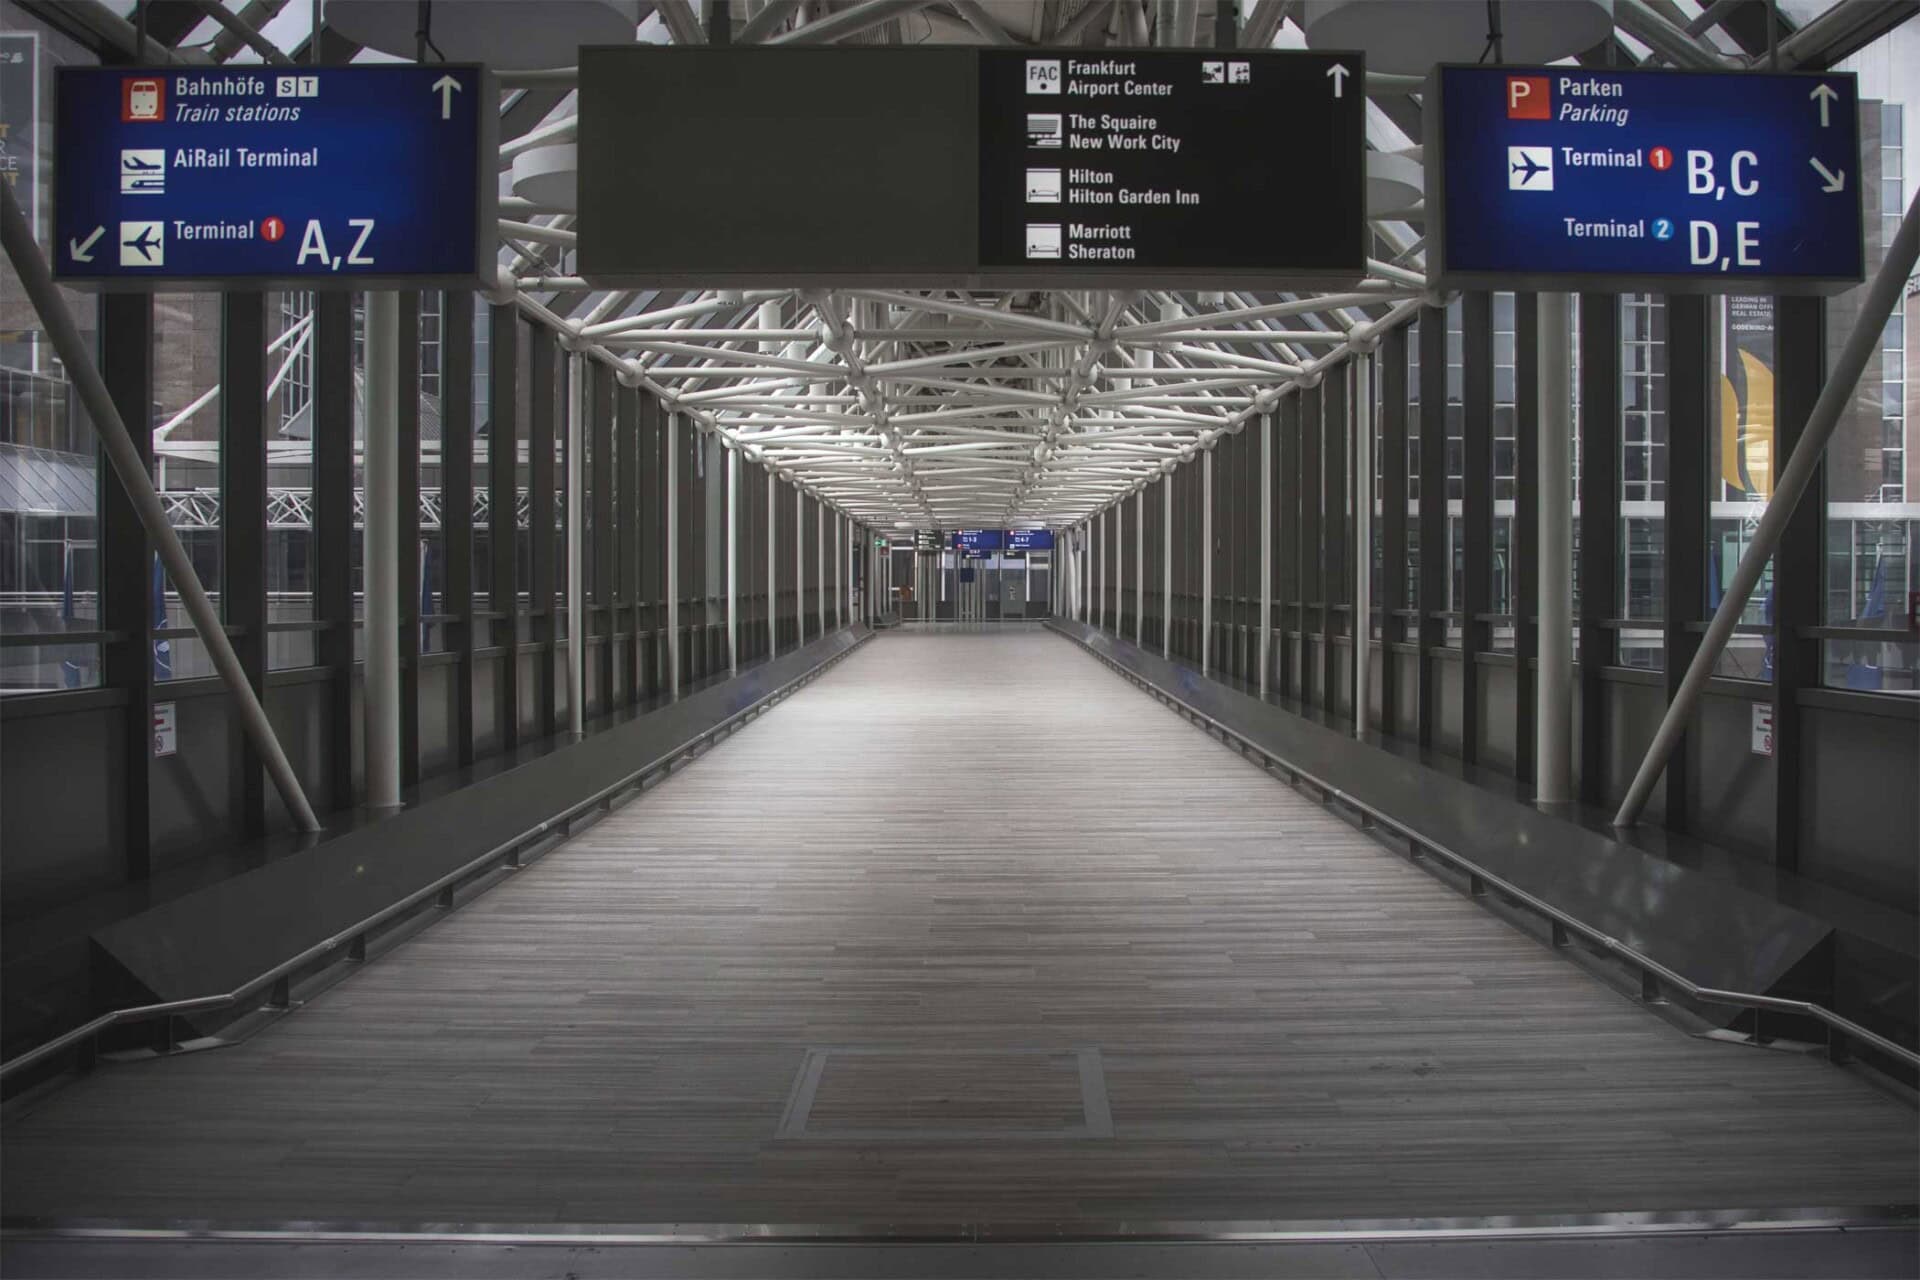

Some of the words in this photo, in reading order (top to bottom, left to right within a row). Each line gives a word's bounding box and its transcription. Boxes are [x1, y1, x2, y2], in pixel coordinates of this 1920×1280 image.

[1030, 66, 1057, 81] FAC
[1068, 59, 1136, 75] Frankfurt
[175, 77, 265, 95] Bahnhöfe
[280, 79, 293, 95] S
[302, 79, 315, 95] T
[1068, 80, 1120, 99] Airport
[1124, 80, 1173, 96] Center
[1510, 81, 1531, 108] P
[1560, 77, 1623, 97] Parken
[174, 103, 219, 122] Train
[225, 103, 300, 122] stations
[1558, 103, 1629, 128] Parking
[1069, 114, 1096, 129] The
[1100, 114, 1157, 133] Squaire
[1069, 134, 1103, 150] New
[1107, 134, 1147, 150] Work
[1151, 134, 1181, 153] City
[174, 148, 231, 168] AiRail
[236, 148, 318, 168] Terminal
[1069, 168, 1114, 185] Hilton
[1561, 146, 1643, 168] Terminal
[1654, 149, 1665, 168] 1
[1686, 149, 1760, 201] B,C
[1069, 188, 1114, 205] Hilton
[1118, 188, 1171, 205] Garden
[1175, 188, 1200, 204] Inn
[1069, 222, 1132, 239] Marriott
[174, 220, 255, 240] Terminal
[267, 221, 278, 238] 1
[297, 219, 376, 271] A,Z
[1068, 243, 1136, 260] Sheraton
[1563, 217, 1645, 239] Terminal
[1656, 219, 1669, 239] 2
[1689, 219, 1761, 272] D,E
